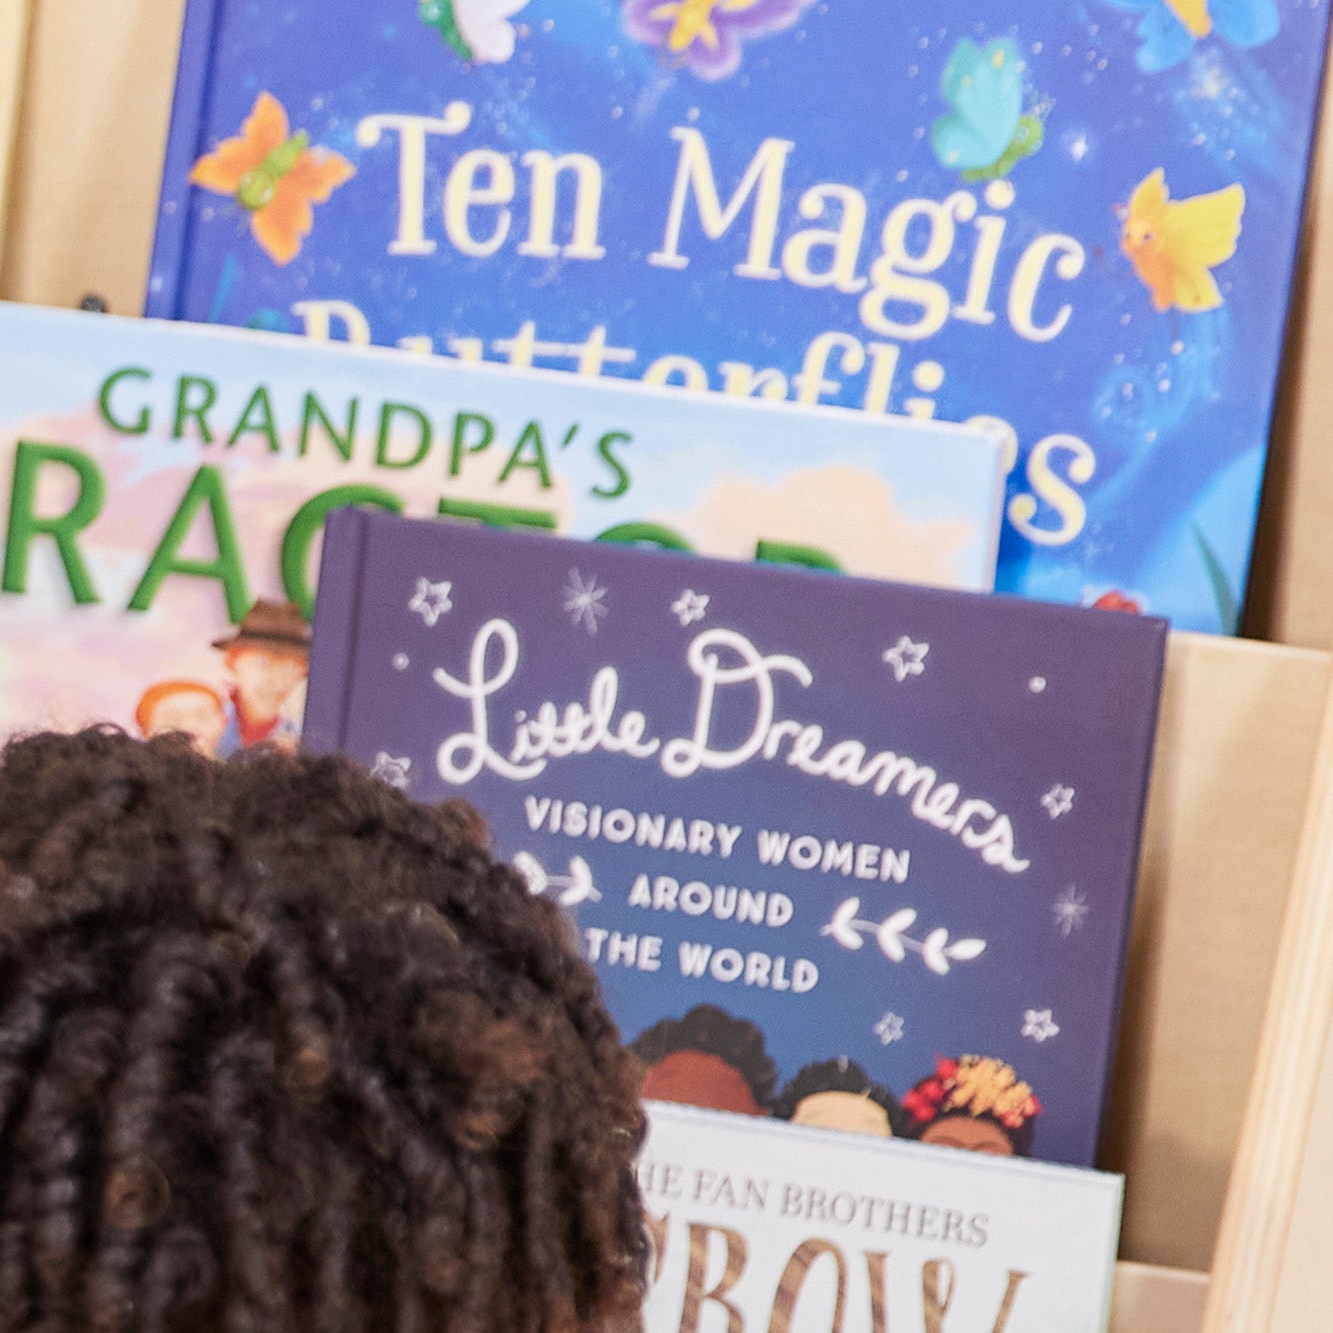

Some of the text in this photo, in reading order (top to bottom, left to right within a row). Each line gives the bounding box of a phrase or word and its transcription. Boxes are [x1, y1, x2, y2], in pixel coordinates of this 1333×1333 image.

[355, 101, 1085, 342] Ten Magic
[98, 367, 636, 500] GRANDPA'S
[433, 618, 1030, 873] Little Dreamers
[525, 794, 911, 884] VISIONARY WOMEN
[627, 873, 794, 928] AROUND
[584, 926, 819, 994] THE WORLD
[691, 1168, 771, 1211] FAN
[779, 1183, 991, 1250] BROTHERS
